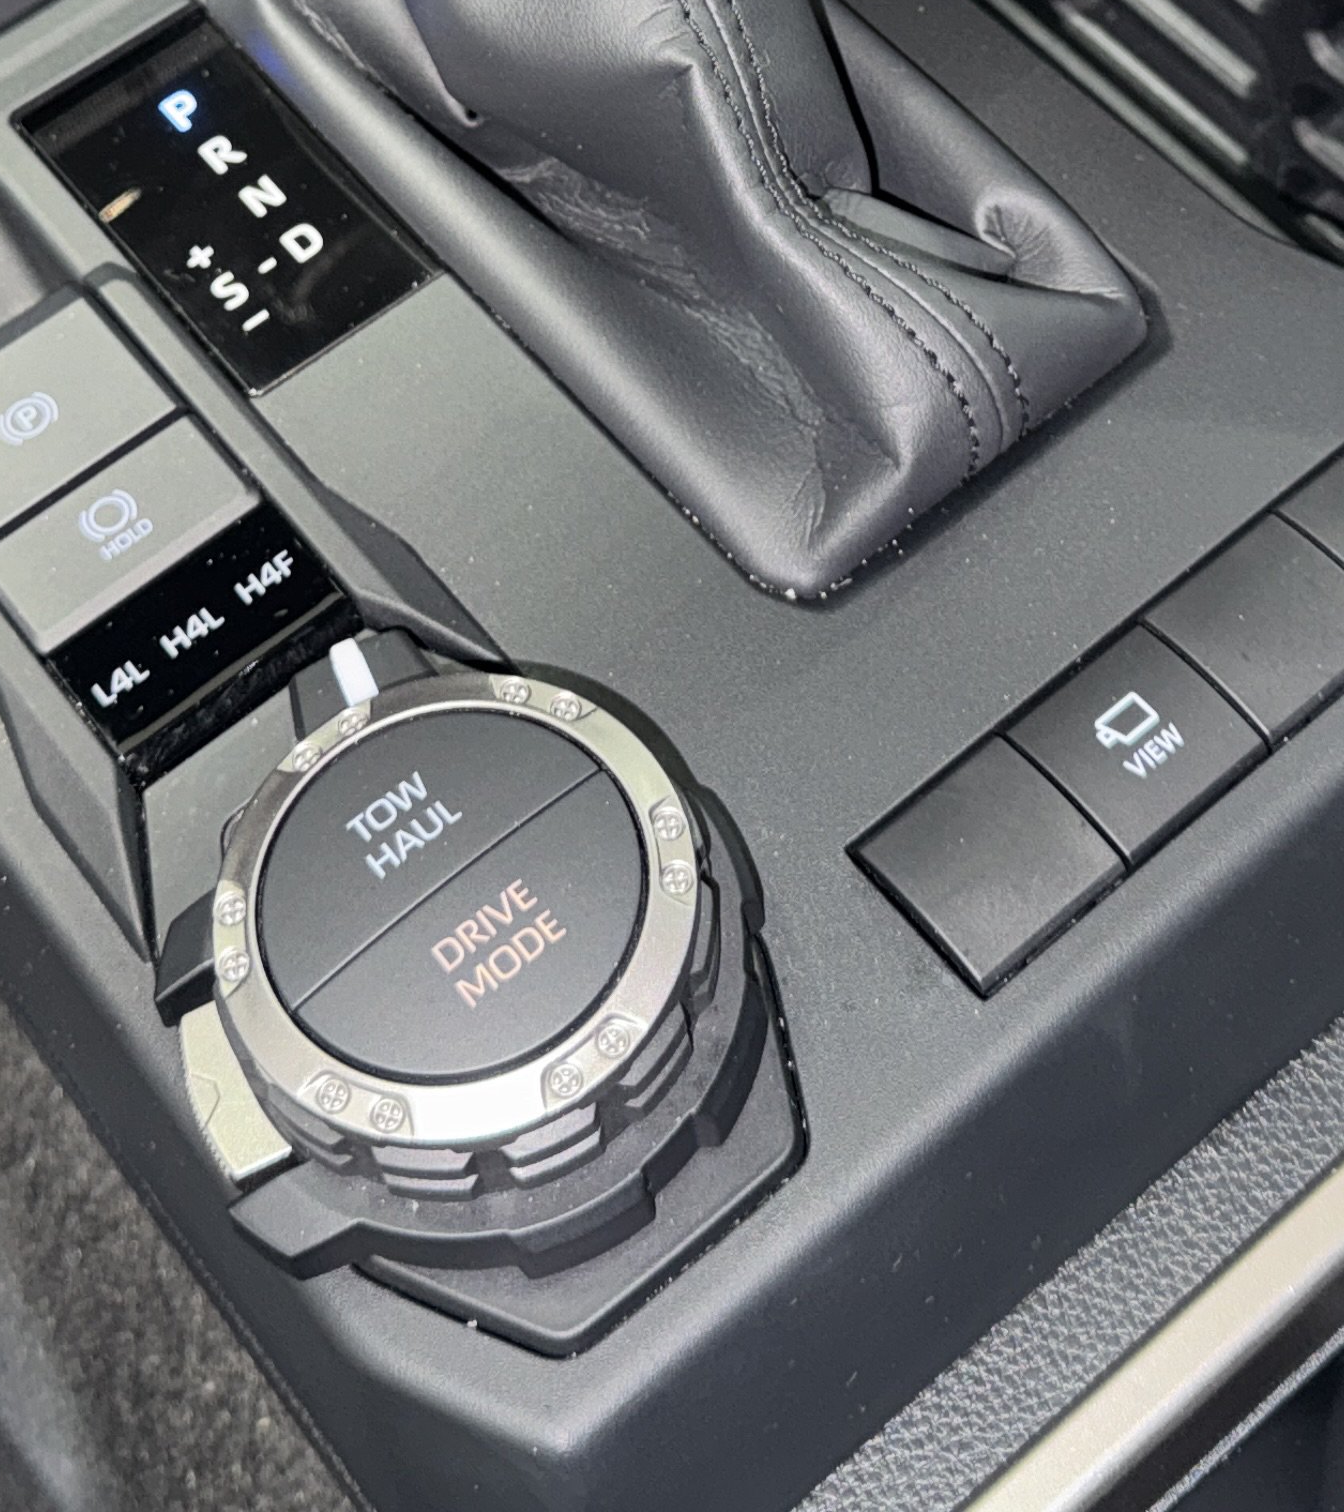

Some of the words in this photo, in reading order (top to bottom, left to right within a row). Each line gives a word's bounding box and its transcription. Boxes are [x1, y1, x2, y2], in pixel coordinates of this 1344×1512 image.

[158, 89, 198, 133] P
[197, 135, 248, 175] R
[238, 174, 287, 218] N
[279, 223, 324, 264] D
[210, 271, 250, 311] S
[101, 519, 152, 560] HOLD
[91, 660, 151, 707] L4L
[159, 607, 225, 658] H4L
[234, 549, 294, 605] H4F
[1122, 722, 1185, 778] VIEW
[345, 771, 428, 842] TOW
[365, 800, 463, 880] HAUL
[430, 878, 538, 974] DRIVE
[454, 908, 567, 1009] MODE
